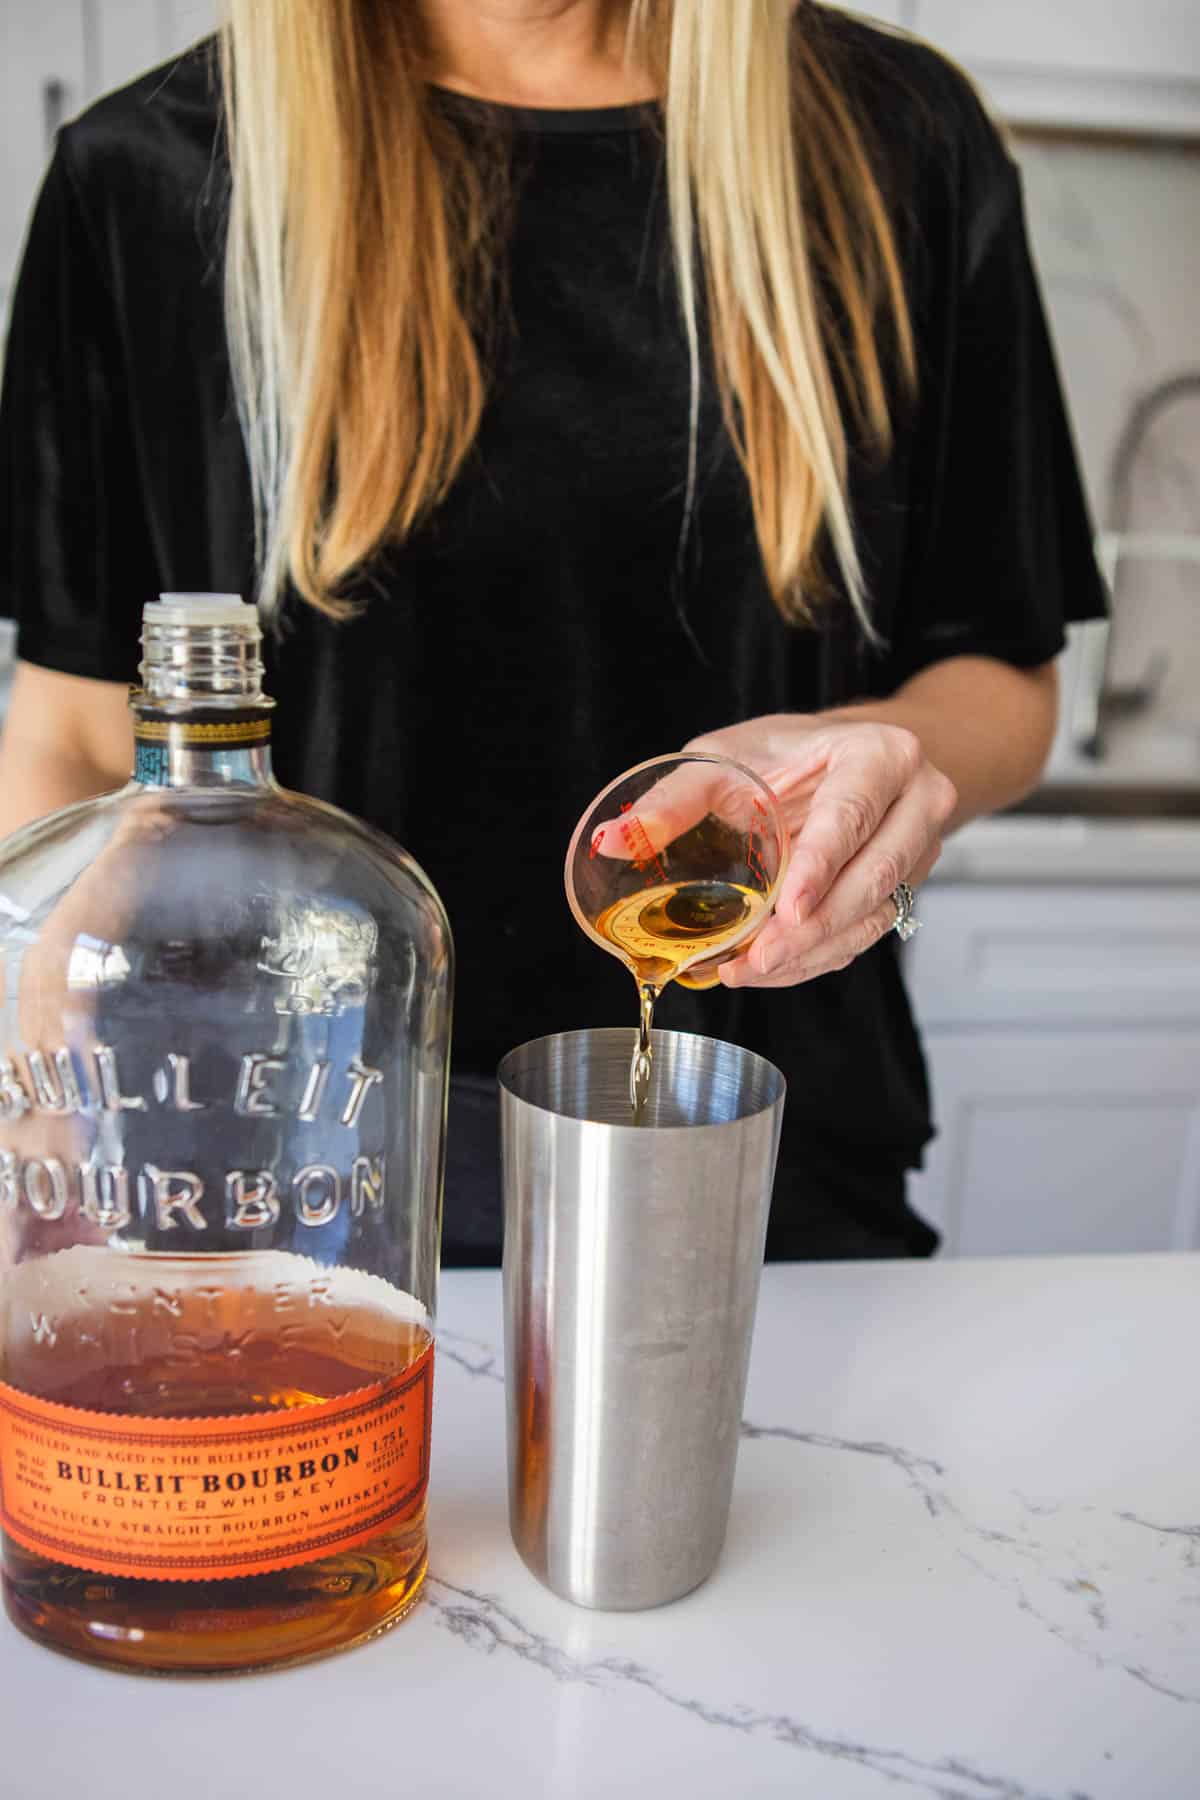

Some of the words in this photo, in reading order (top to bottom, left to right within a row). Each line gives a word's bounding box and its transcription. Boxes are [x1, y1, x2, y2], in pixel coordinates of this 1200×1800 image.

[11, 1423, 70, 1452] DISTILLED
[76, 1447, 101, 1458] AND
[107, 1450, 145, 1464] AGED
[151, 1455, 165, 1464] IN
[172, 1455, 200, 1465] THE
[207, 1448, 271, 1465] BULLEIT
[277, 1436, 330, 1456] FAMILY
[336, 1403, 406, 1441] TRADITION
[56, 1459, 185, 1494] BULLEIT
[201, 1444, 360, 1494] BOURBON
[81, 1490, 207, 1511] FRONTIER
[221, 1478, 336, 1509] WHISKEY
[32, 1499, 112, 1529] KENTUCKY
[120, 1521, 212, 1535] STRAIGHT
[222, 1511, 309, 1534] BOURBON
[319, 1479, 390, 1513] WHISKEY
